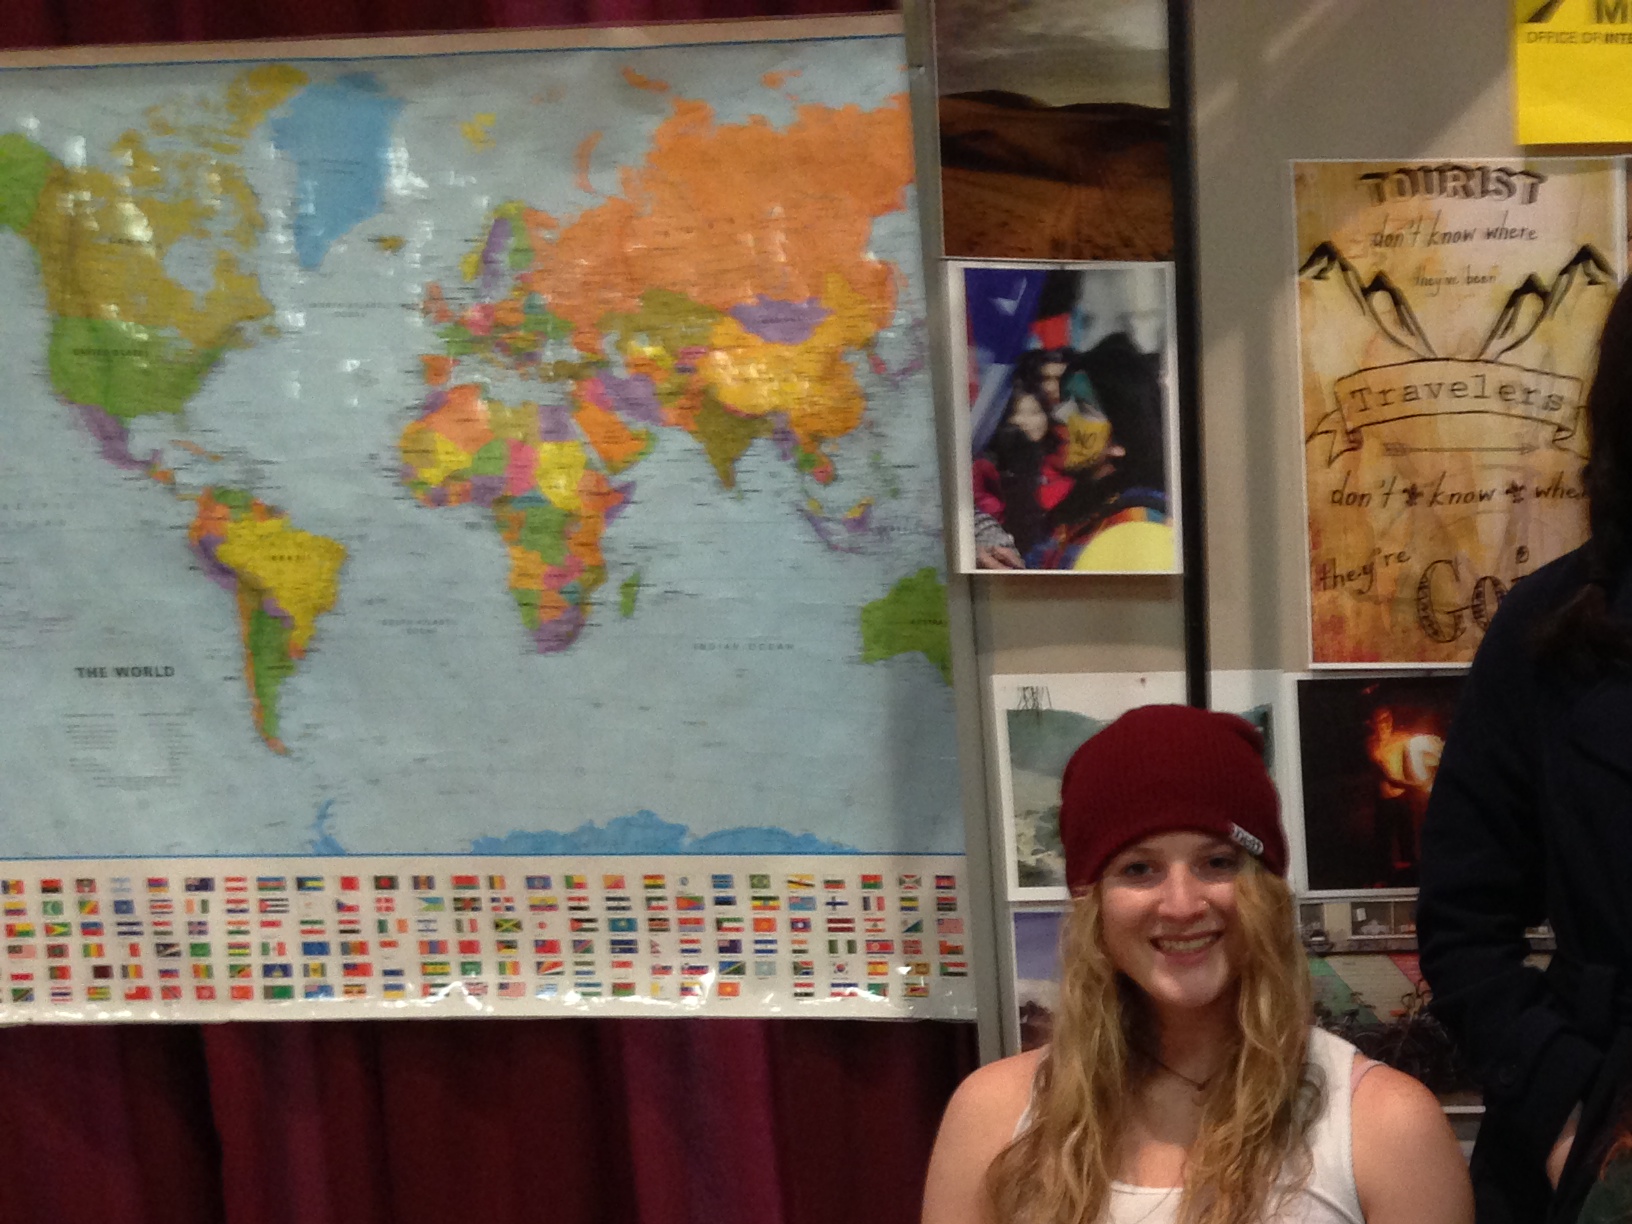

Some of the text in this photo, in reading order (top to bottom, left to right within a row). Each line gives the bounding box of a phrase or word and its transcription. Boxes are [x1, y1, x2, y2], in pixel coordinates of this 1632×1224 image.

[1527, 31, 1577, 45] OFFICE
[1582, 32, 1603, 45] OF
[1358, 163, 1548, 206] TOURIST
[1370, 210, 1538, 248] don't know where
[1348, 373, 1566, 413] Travelers
[1330, 470, 1396, 508] don't
[1428, 470, 1497, 506] know
[1319, 546, 1411, 596] they're
[74, 665, 176, 679] THE WORLD
